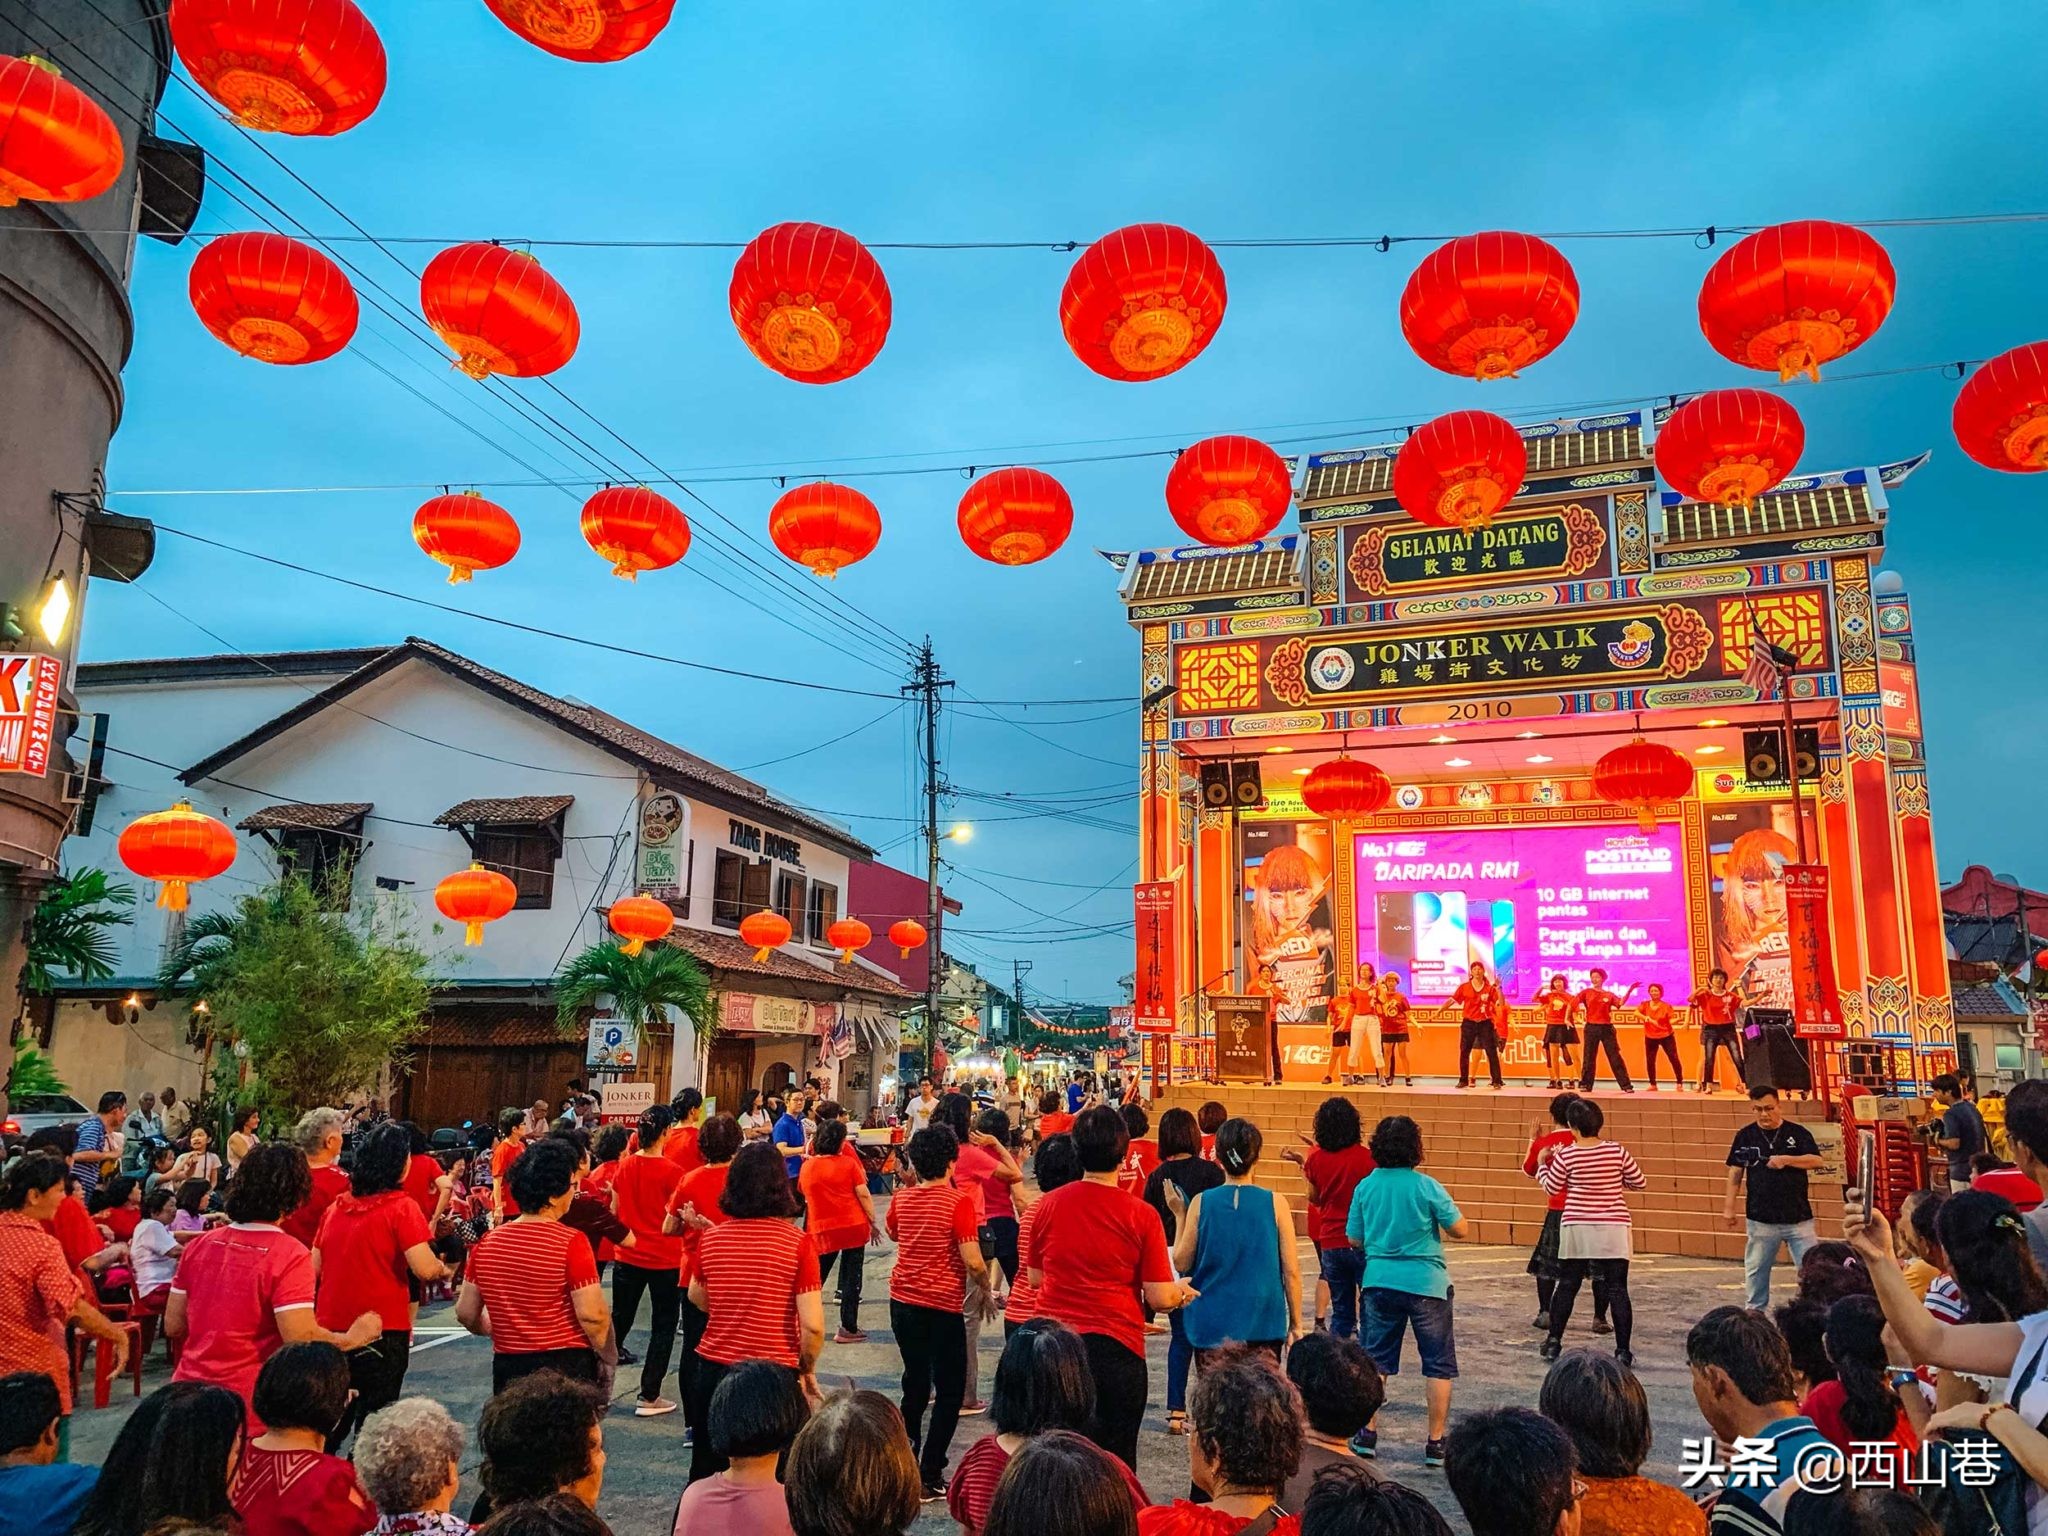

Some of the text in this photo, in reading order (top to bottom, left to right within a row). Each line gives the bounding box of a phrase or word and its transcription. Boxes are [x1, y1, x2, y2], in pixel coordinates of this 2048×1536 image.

[1390, 523, 1560, 559] SELAMAT DATANG
[1424, 550, 1525, 576] 歡迎光臨
[1364, 627, 1598, 665] JONKER WALK
[1379, 653, 1583, 685] 雞場街文化坊
[1447, 701, 1512, 720] 2010
[729, 818, 801, 865] TANG HOUSE
[1362, 841, 1393, 858] No.1
[646, 850, 671, 866] Big
[1586, 848, 1671, 863] POSTPAID
[643, 863, 675, 877] Tart
[1480, 861, 1519, 880] RM1
[1537, 887, 1649, 902] 10 GB internet
[1537, 904, 1588, 920] pantas
[1539, 926, 1647, 943] Panggilan dan
[1280, 936, 1312, 956] RED
[1539, 941, 1657, 959] SMS tanpa had
[610, 1032, 618, 1042] P
[1293, 1045, 1321, 1064] 4G
[607, 1091, 651, 1102] JONKER
